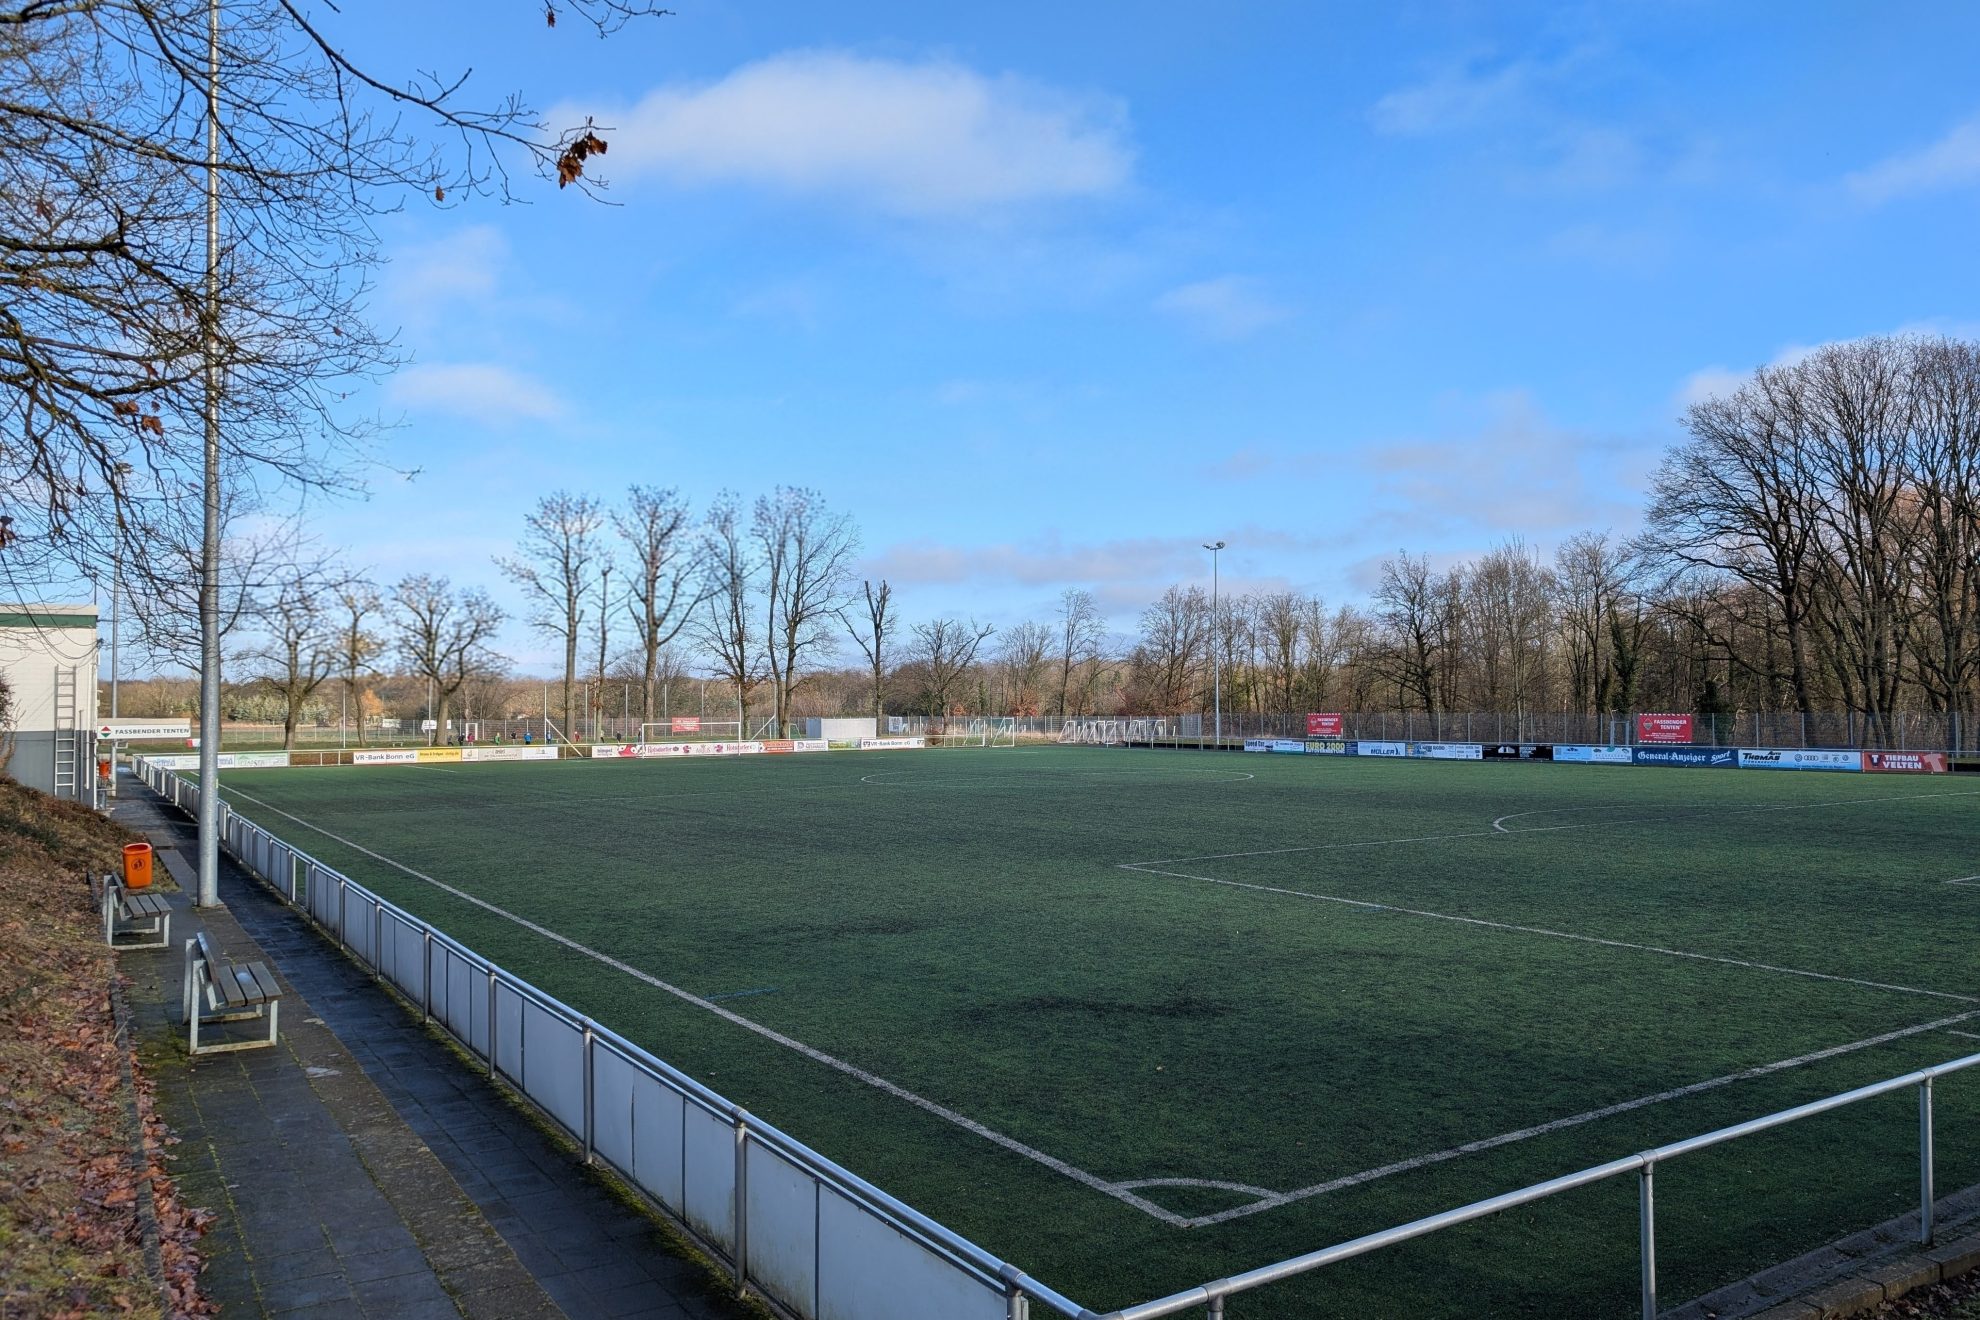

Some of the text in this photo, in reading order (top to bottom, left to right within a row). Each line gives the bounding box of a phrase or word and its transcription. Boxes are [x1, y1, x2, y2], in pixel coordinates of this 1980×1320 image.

[1305, 741, 1325, 750] EURO
[1326, 741, 1345, 750] 2000
[1637, 751, 1706, 762] General-Anzeiger
[1710, 750, 1731, 762] Sport
[1742, 752, 1780, 761] THOMAS
[1884, 754, 1919, 762] TIEFBAU
[1882, 761, 1922, 769] VELTEN
